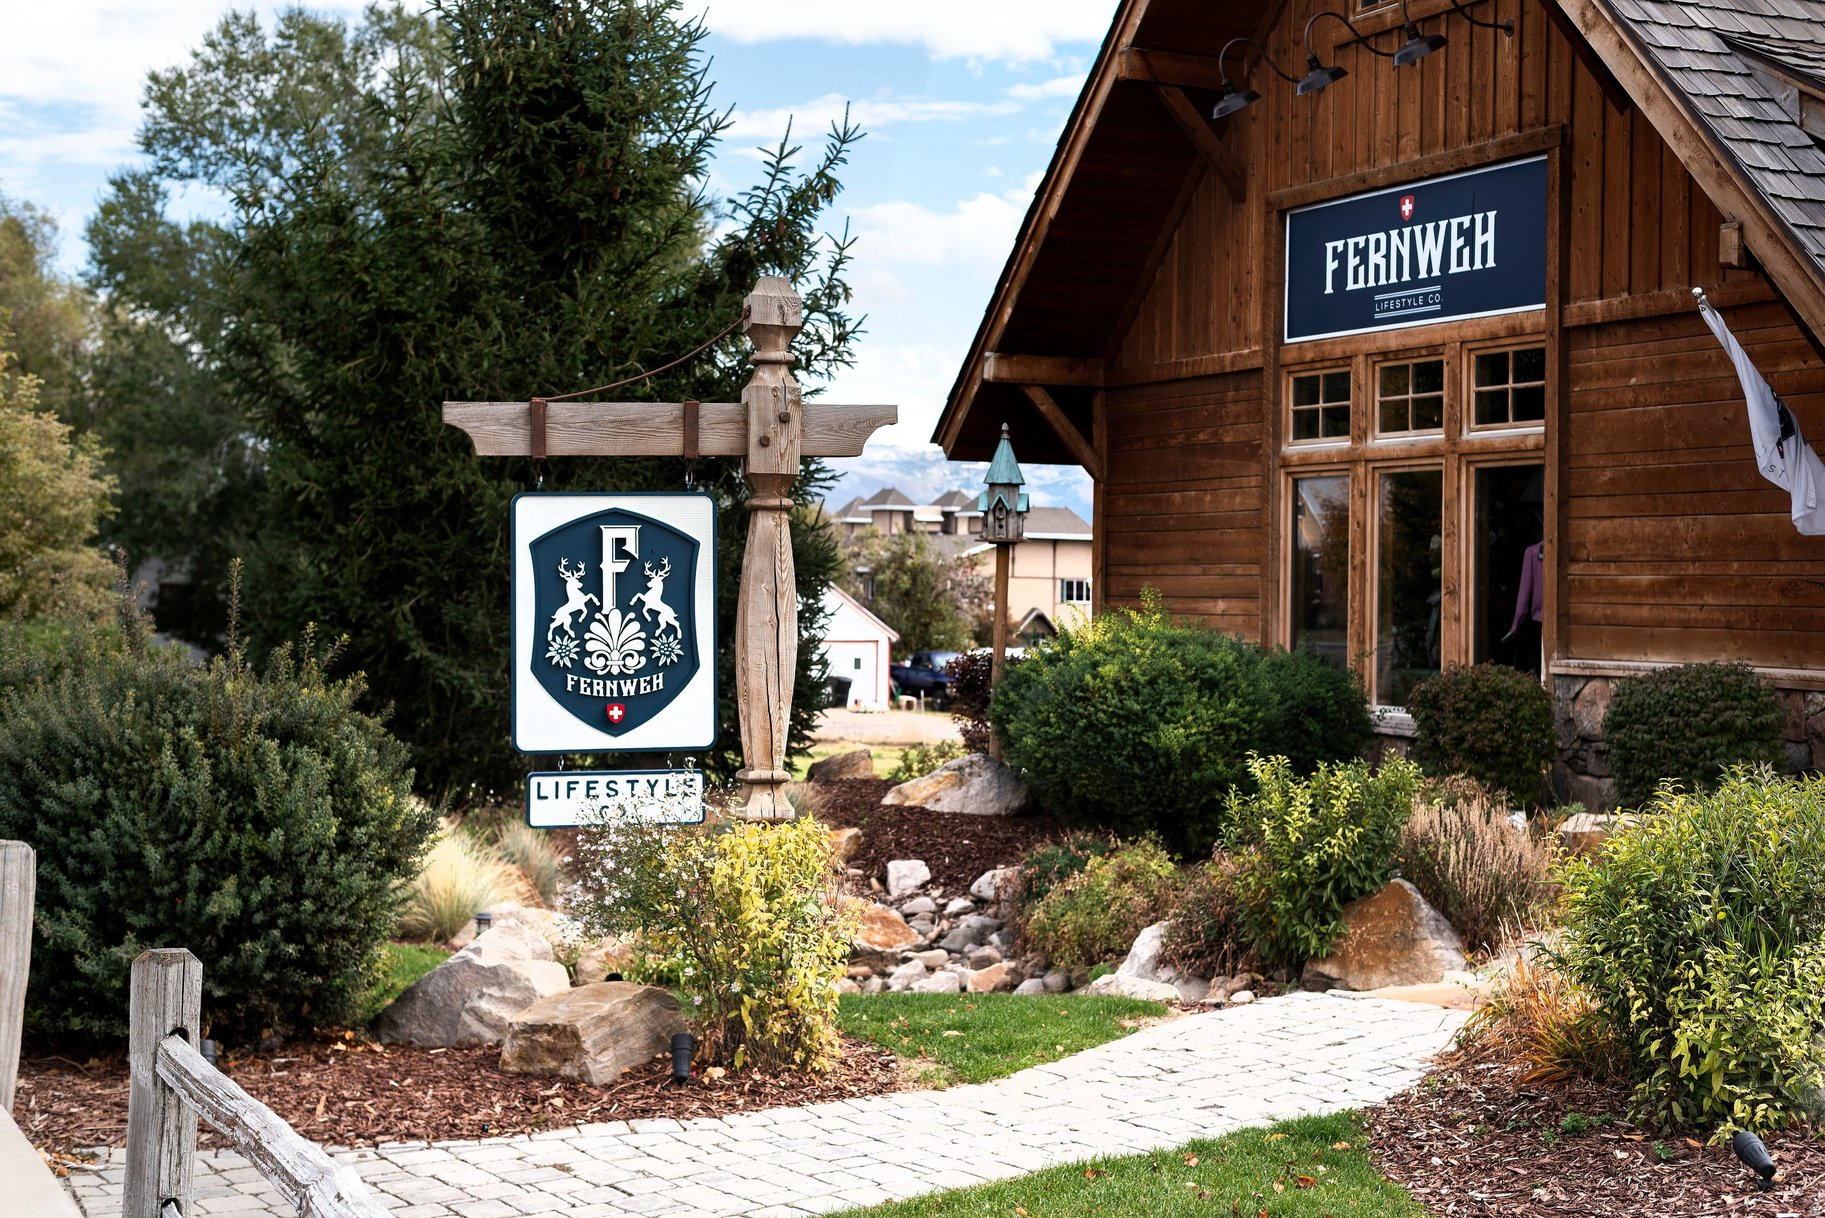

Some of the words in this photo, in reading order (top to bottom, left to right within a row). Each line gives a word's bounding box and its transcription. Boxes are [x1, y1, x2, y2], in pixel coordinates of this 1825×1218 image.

[1325, 211, 1497, 294] FERNWEH
[1375, 295, 1424, 311] LIFESTYLE
[566, 672, 664, 697] FERNWEH
[536, 778, 696, 800] LIFESTYLE
